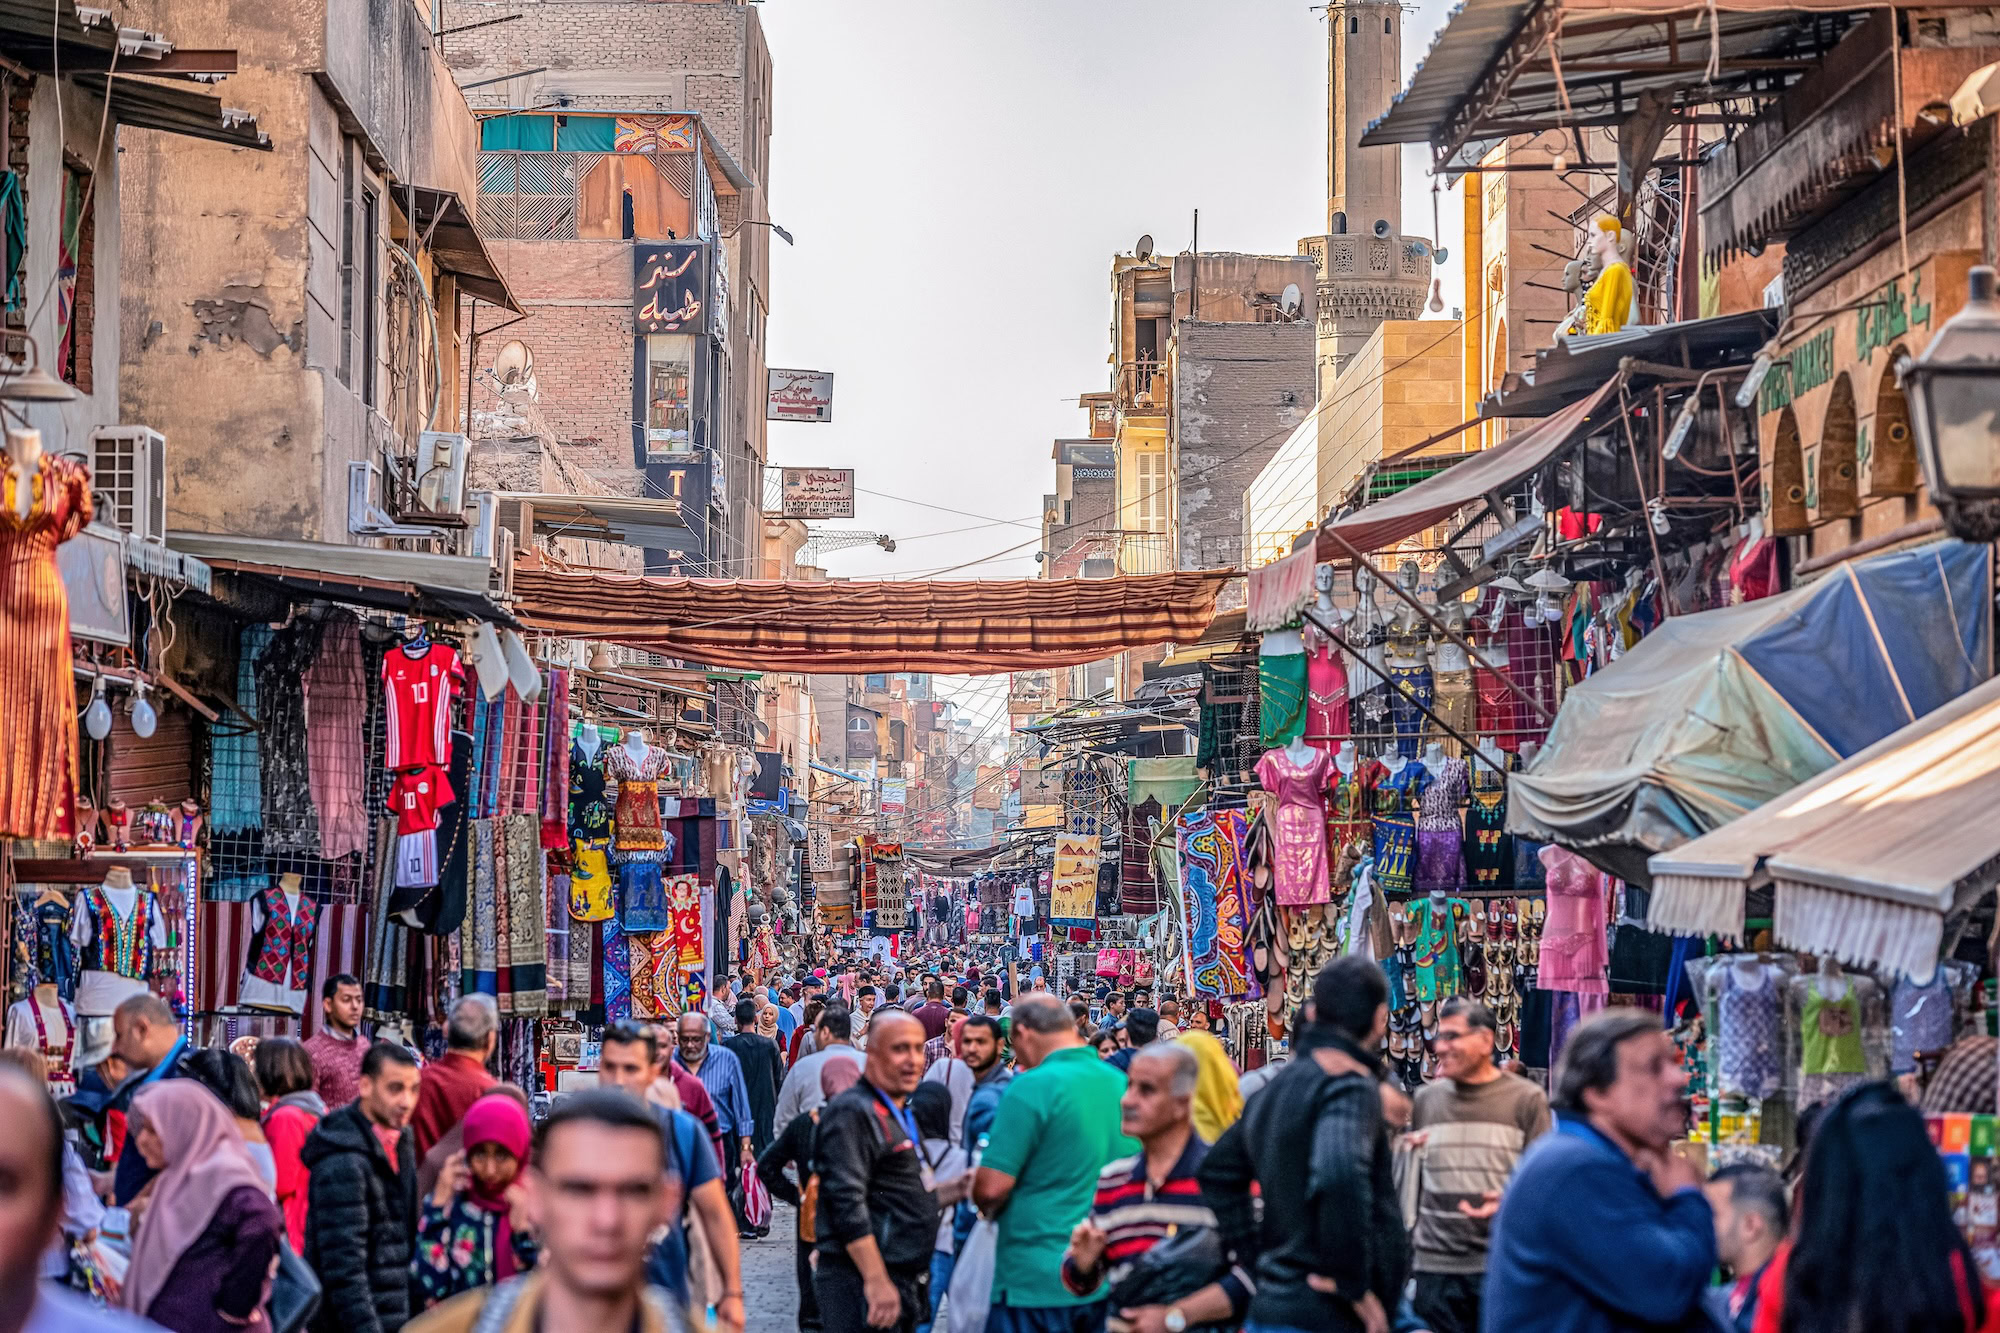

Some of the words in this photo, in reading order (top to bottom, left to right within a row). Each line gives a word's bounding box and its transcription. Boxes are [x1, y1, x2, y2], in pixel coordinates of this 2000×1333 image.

[639, 249, 697, 290] سنتر
[1792, 326, 1834, 400] MARKET
[411, 682, 429, 704] 10
[404, 791, 417, 810] 10
[409, 858, 420, 873] 10
